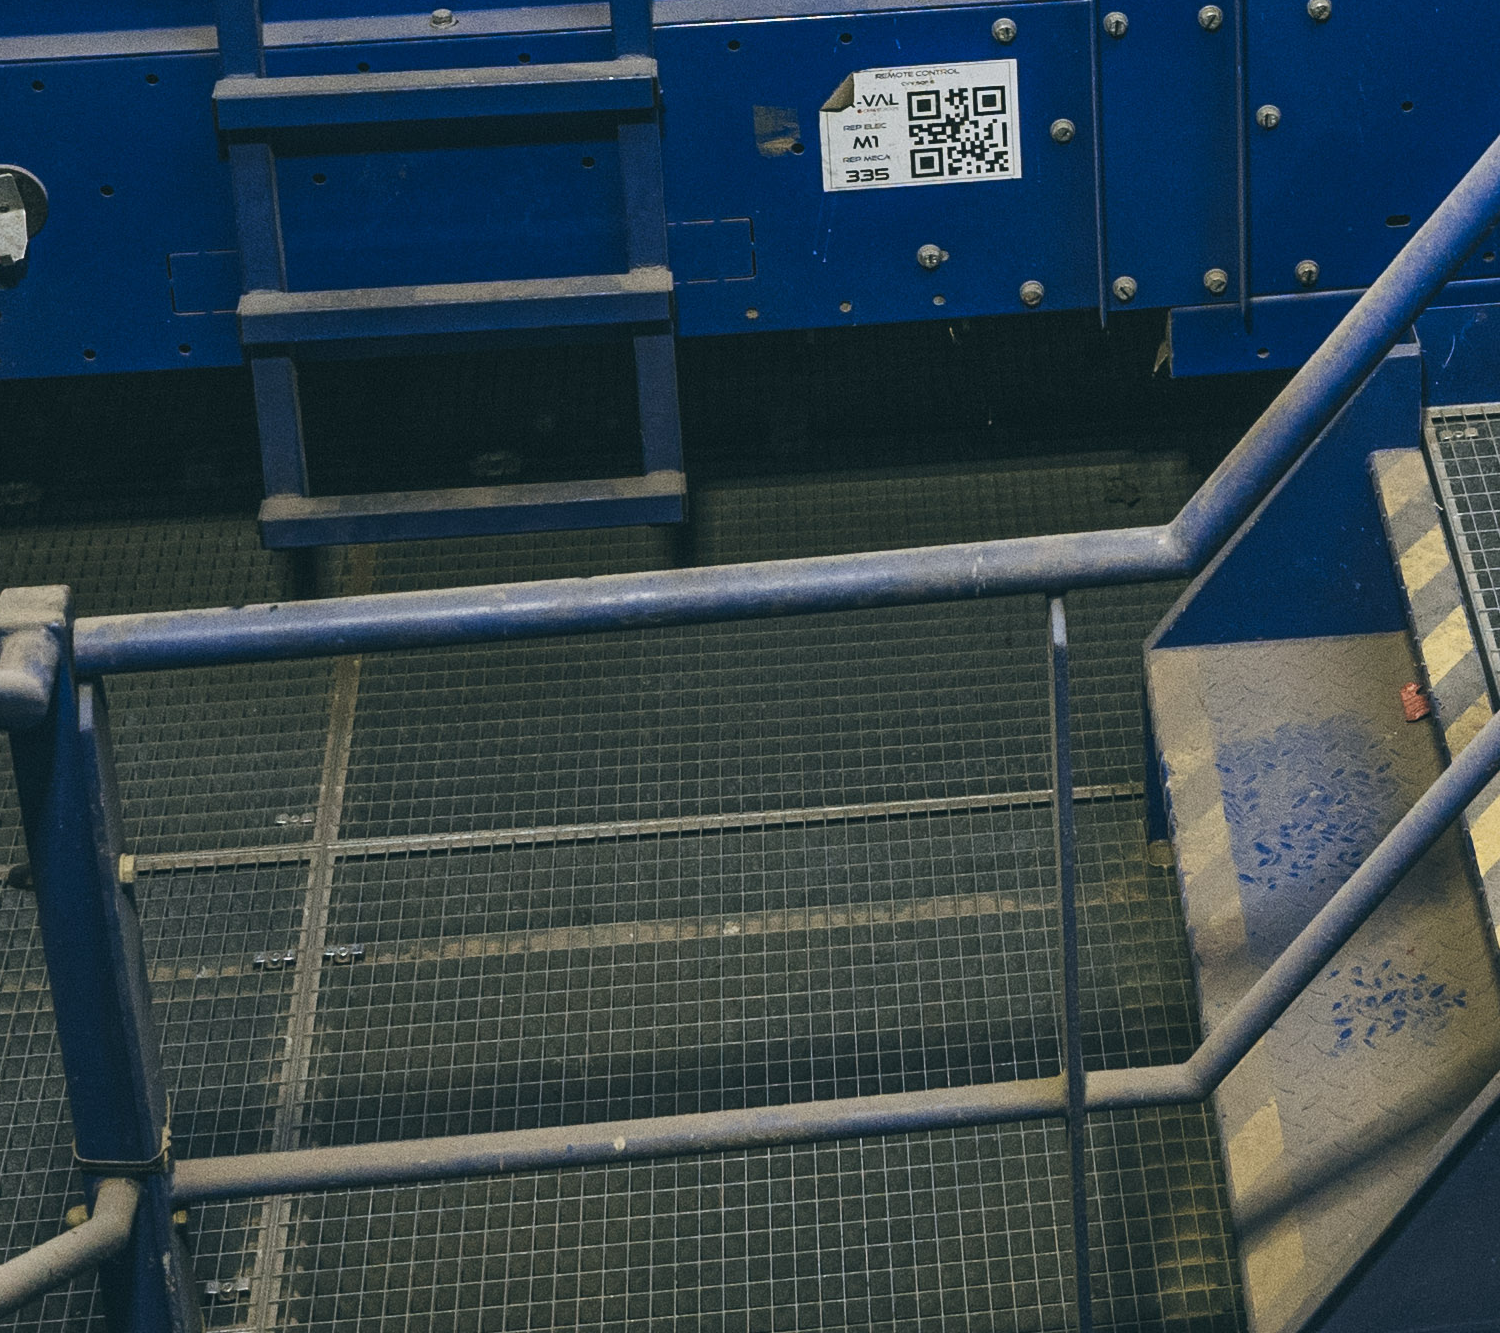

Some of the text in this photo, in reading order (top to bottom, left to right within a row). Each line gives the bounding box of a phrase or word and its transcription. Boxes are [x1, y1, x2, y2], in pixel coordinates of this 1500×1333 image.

[875, 68, 961, 80] REMOTE CONTROL
[853, 136, 879, 149] M1
[846, 168, 890, 183] 335
